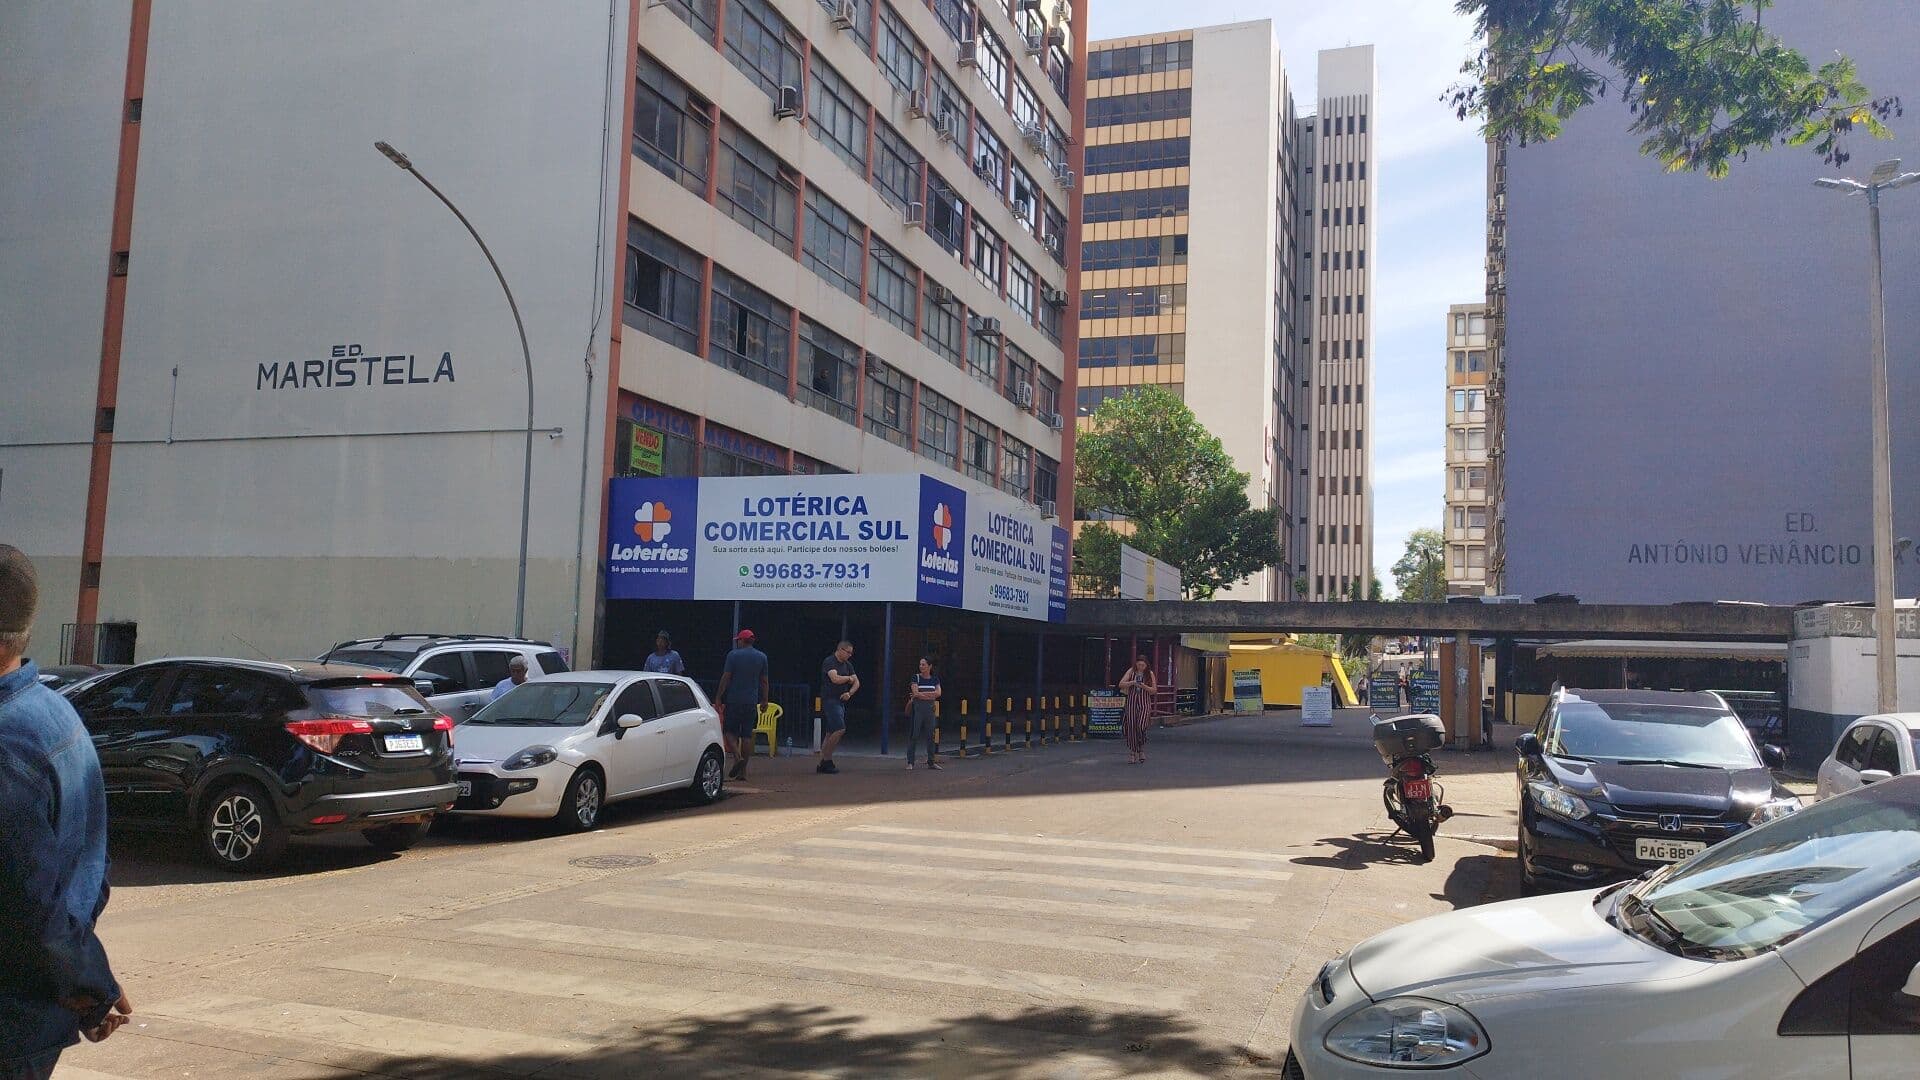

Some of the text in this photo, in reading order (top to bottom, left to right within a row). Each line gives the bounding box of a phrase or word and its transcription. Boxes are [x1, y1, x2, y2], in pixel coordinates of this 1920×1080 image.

[331, 343, 364, 358] ED.
[256, 351, 456, 391] MARISTELA
[743, 492, 869, 517] LOTÉRICA
[704, 520, 909, 542] COMERCIAL SUL
[988, 511, 1034, 546] LOTÉRICA
[1785, 512, 1818, 533] ED.
[611, 542, 689, 562] Loterias
[712, 545, 727, 553] Sua
[787, 545, 821, 554] Participe
[822, 545, 837, 553] dos
[921, 546, 959, 575] Loterias
[971, 534, 1046, 575] COMERCIAL SUL
[1738, 538, 1861, 565] VENÂNCIO
[641, 566, 659, 574] quem
[752, 562, 870, 579] 99683-7931
[994, 583, 1029, 605] 99683-7931
